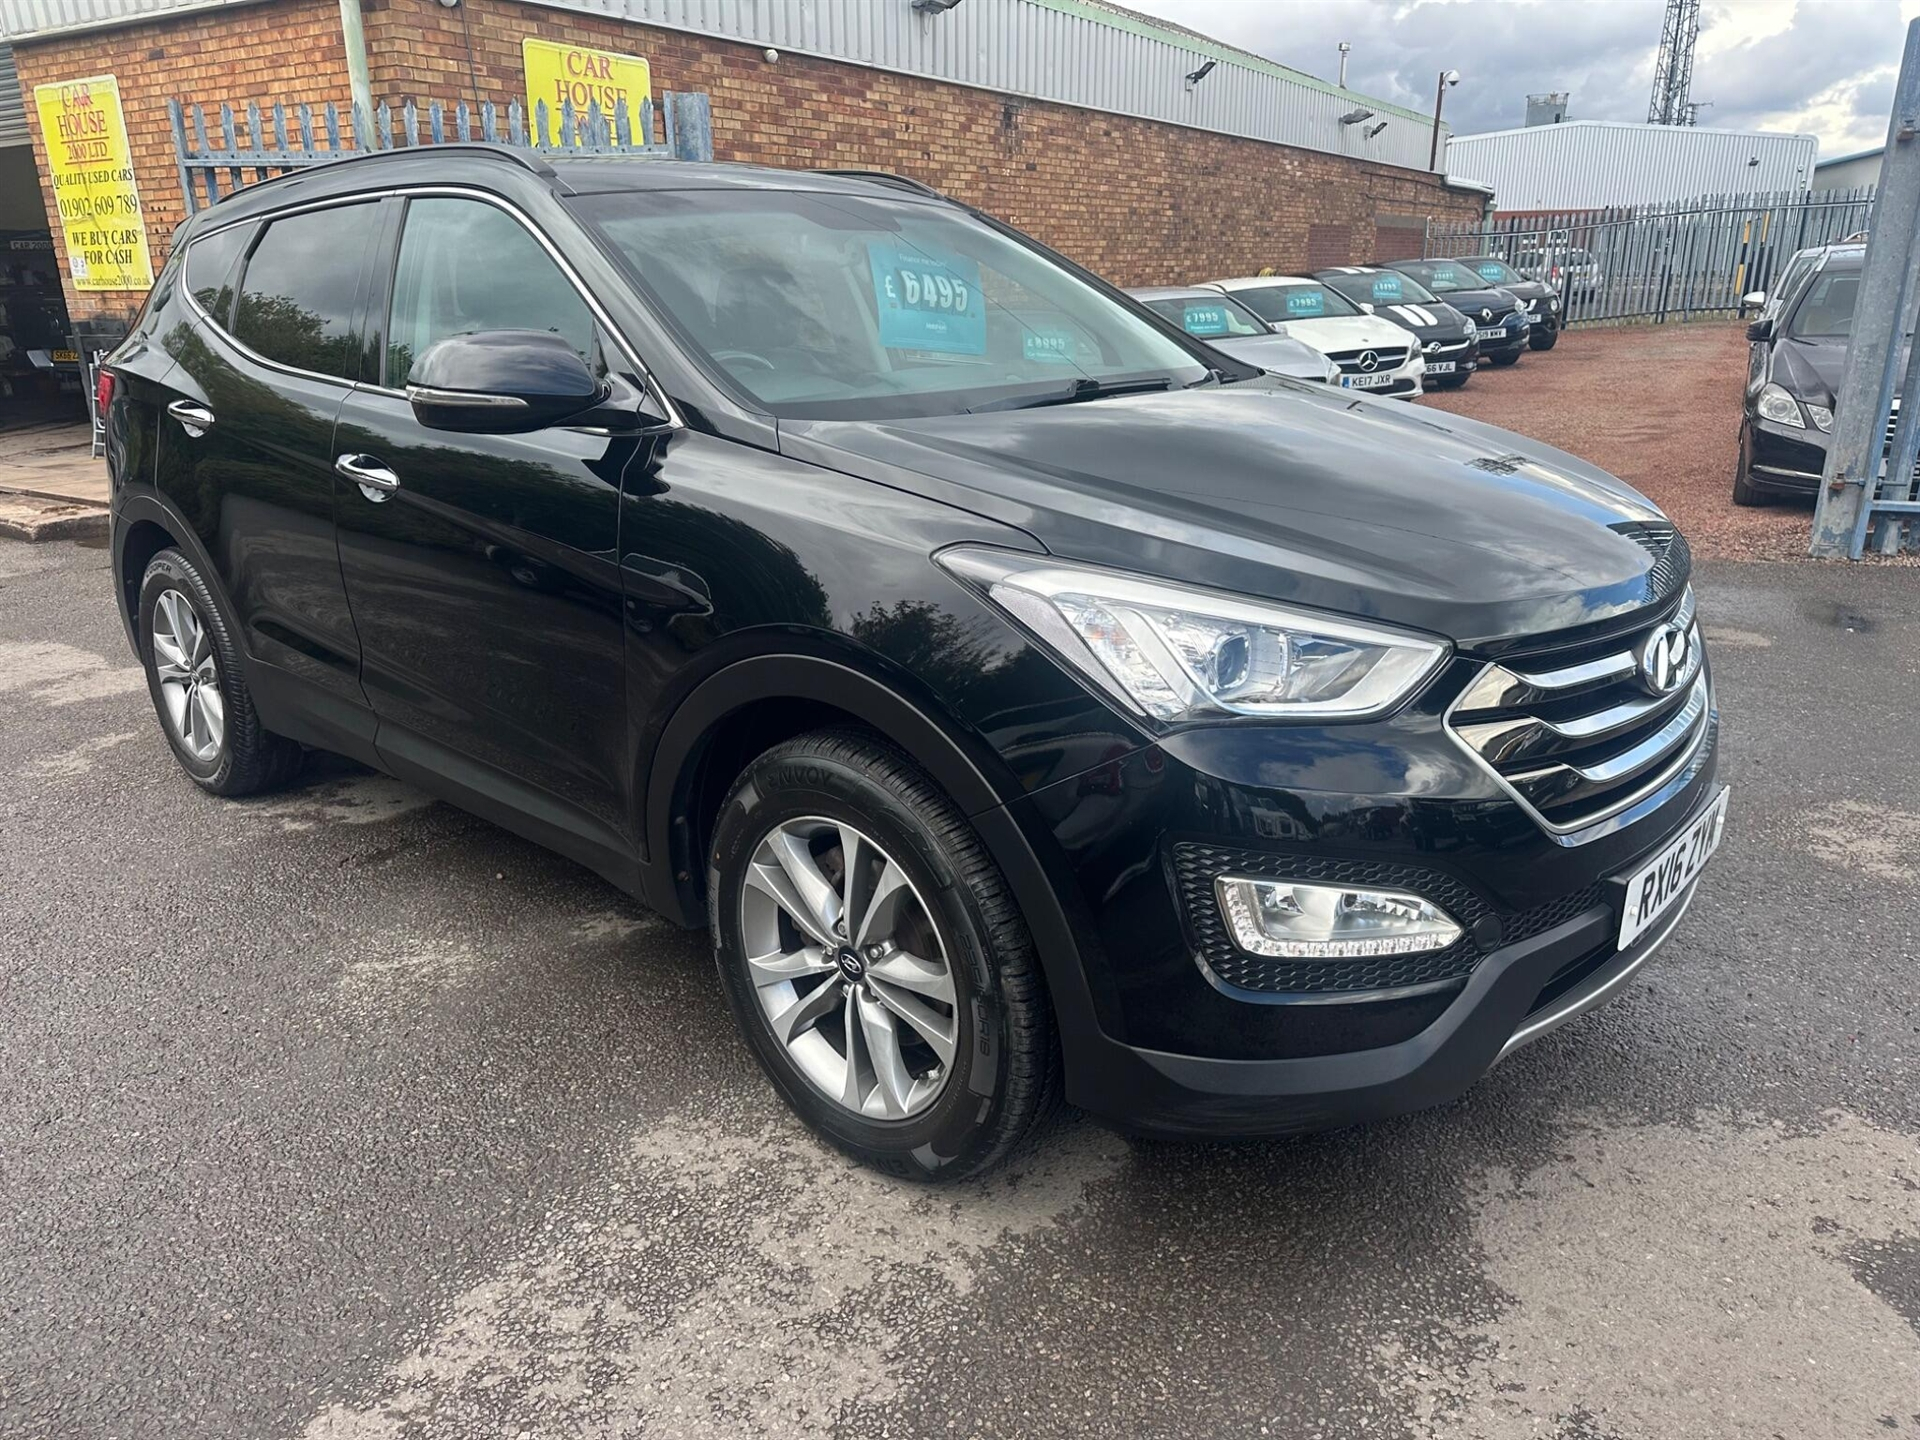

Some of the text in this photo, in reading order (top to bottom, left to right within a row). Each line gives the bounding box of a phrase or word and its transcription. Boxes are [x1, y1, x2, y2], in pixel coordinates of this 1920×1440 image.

[566, 51, 614, 80] CAR
[61, 84, 94, 108] CAR
[554, 78, 627, 110] HOUSE
[56, 109, 108, 137] HOUSE
[67, 141, 108, 160] 2000 LTD
[53, 168, 133, 190] QUALITY USED CARS
[59, 193, 138, 218] 01902 609 789
[72, 229, 138, 247] WE BUY CARS
[84, 249, 133, 265] FOR CASH
[76, 275, 152, 287] www.carhouse2000.co.uk
[1438, 362, 1453, 372] VJL
[1352, 374, 1391, 387] KE17 JXR
[765, 764, 834, 790] ENVOY
[1636, 842, 1687, 928] RX16
